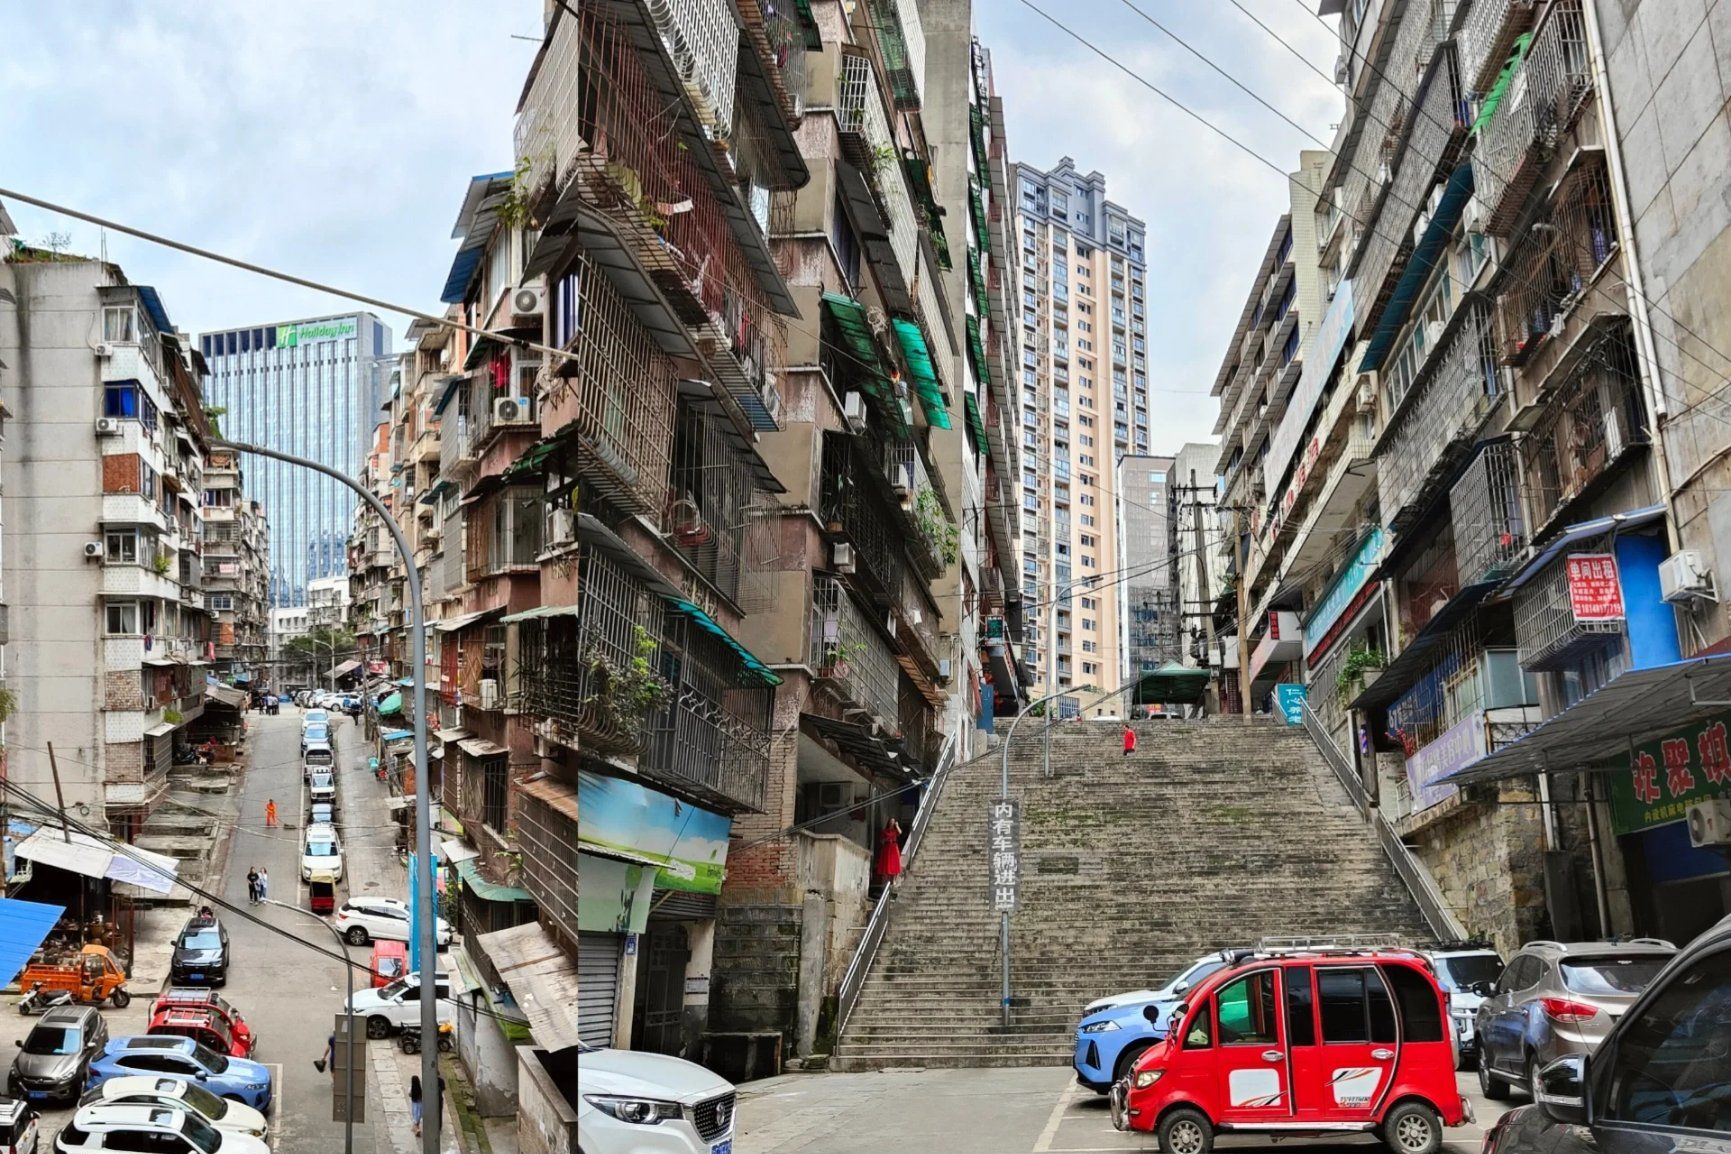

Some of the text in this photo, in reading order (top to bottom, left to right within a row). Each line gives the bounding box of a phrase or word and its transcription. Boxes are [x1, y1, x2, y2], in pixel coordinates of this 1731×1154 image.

[300, 323, 355, 339] Holiday Inn
[1569, 560, 1615, 580] 单间出租
[992, 802, 1017, 910] 内有车辆进出
